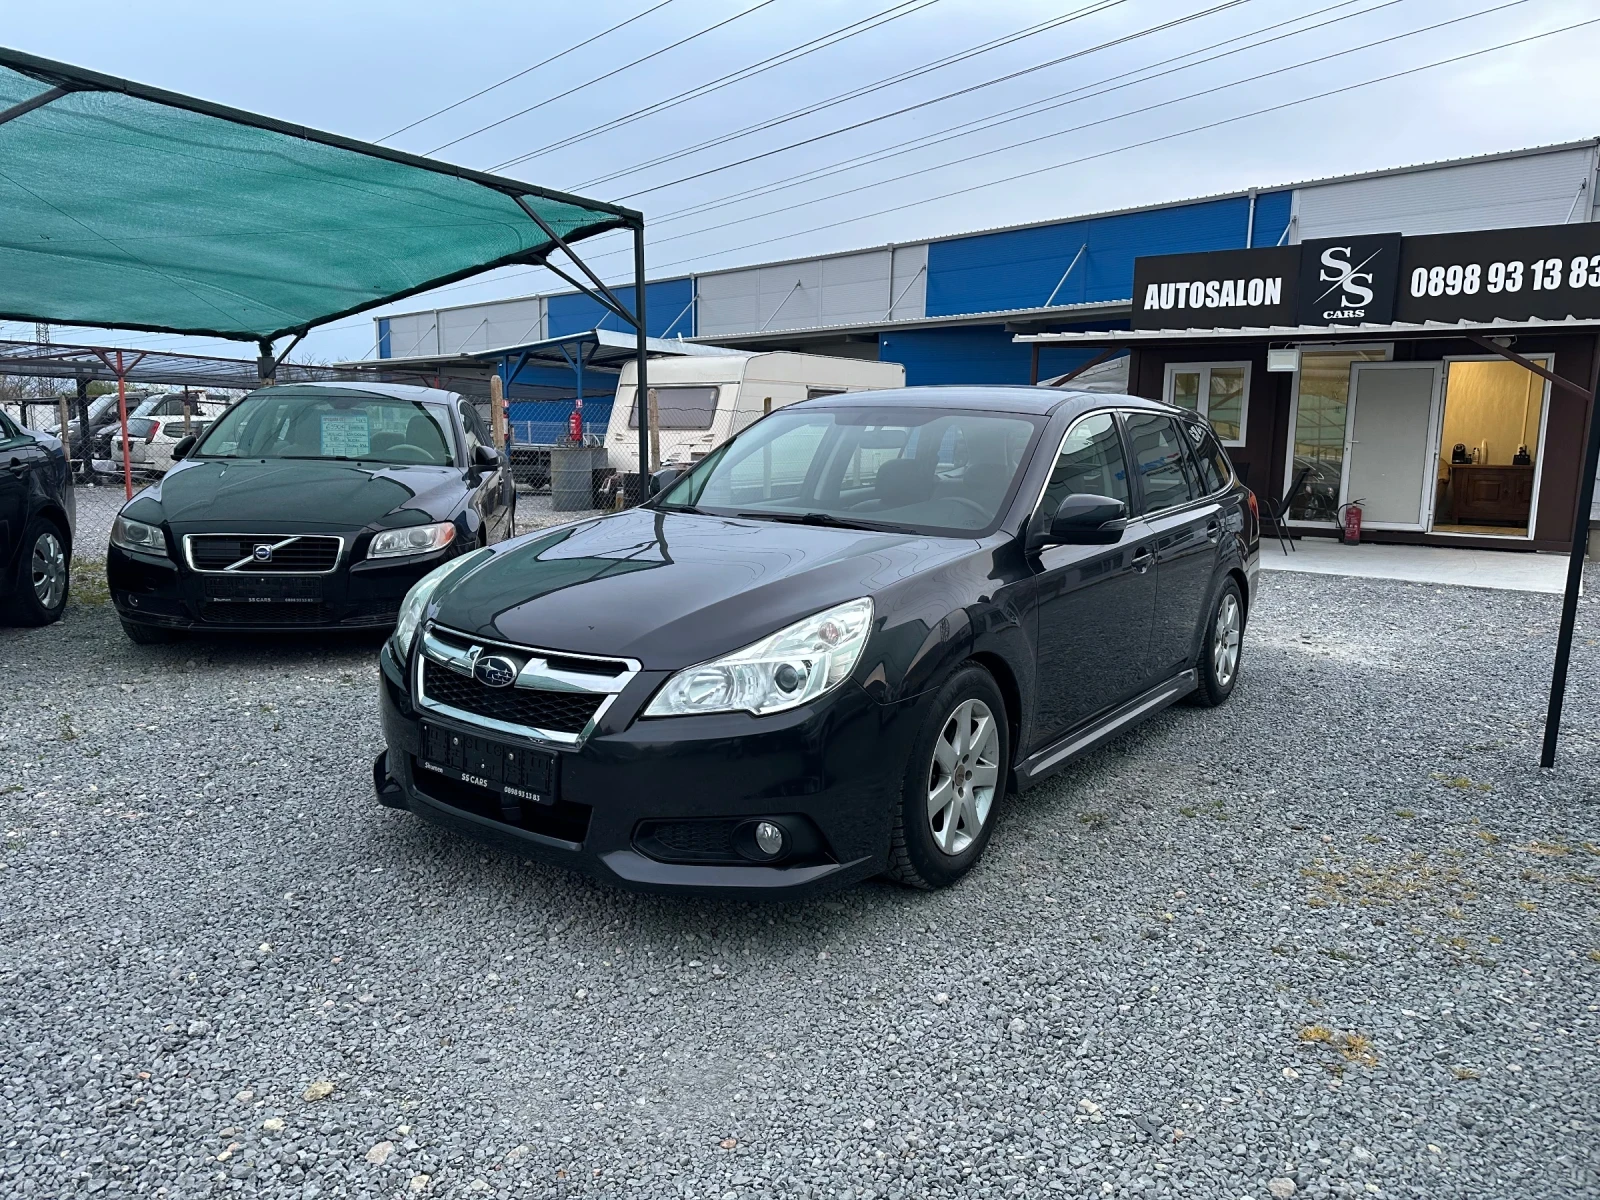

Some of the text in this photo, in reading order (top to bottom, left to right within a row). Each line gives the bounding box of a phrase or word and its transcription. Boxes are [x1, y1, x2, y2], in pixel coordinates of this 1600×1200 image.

[1410, 254, 1600, 298] 0898 93 13 83
[1144, 277, 1282, 310] AUTOSALON
[1322, 309, 1365, 319] CARS
[461, 773, 488, 788] SS CARS
[504, 786, 540, 802] 0898 93 13 83
